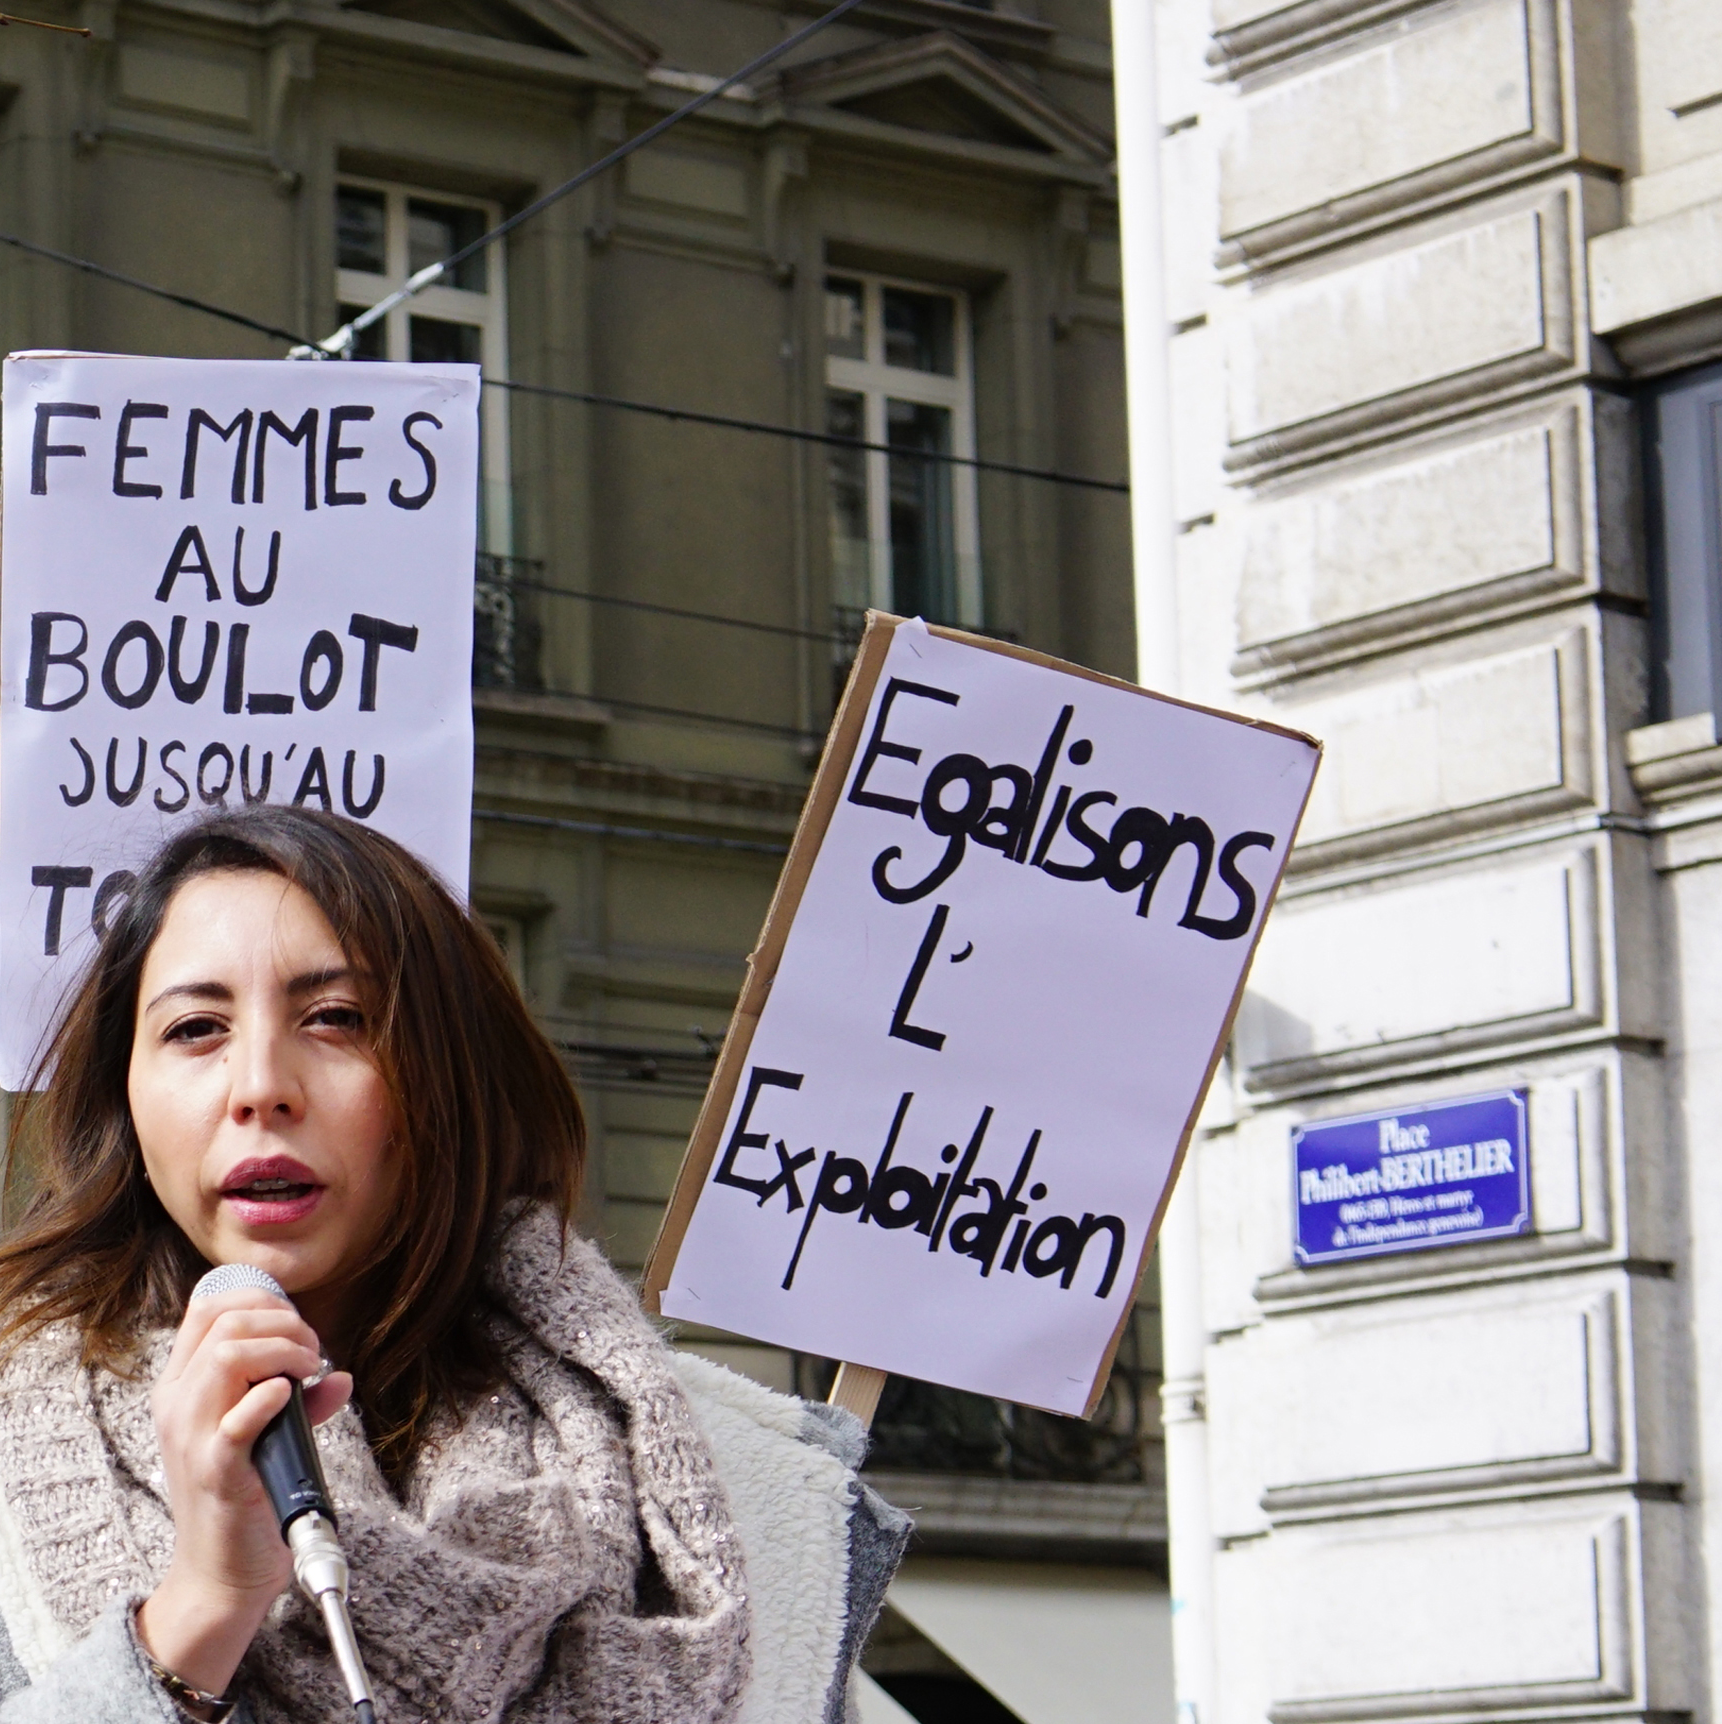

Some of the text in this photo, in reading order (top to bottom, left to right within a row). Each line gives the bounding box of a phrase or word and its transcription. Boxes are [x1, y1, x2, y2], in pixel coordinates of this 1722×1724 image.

[30, 399, 444, 512] FEMMES
[155, 524, 282, 607] AU
[24, 611, 418, 715] BOULOT
[58, 737, 386, 820] JUSQU'AU
[848, 675, 1275, 941] Egalisons
[888, 904, 973, 1051] L'
[712, 1066, 1126, 1300] Exploitation
[1378, 1117, 1430, 1154] Place
